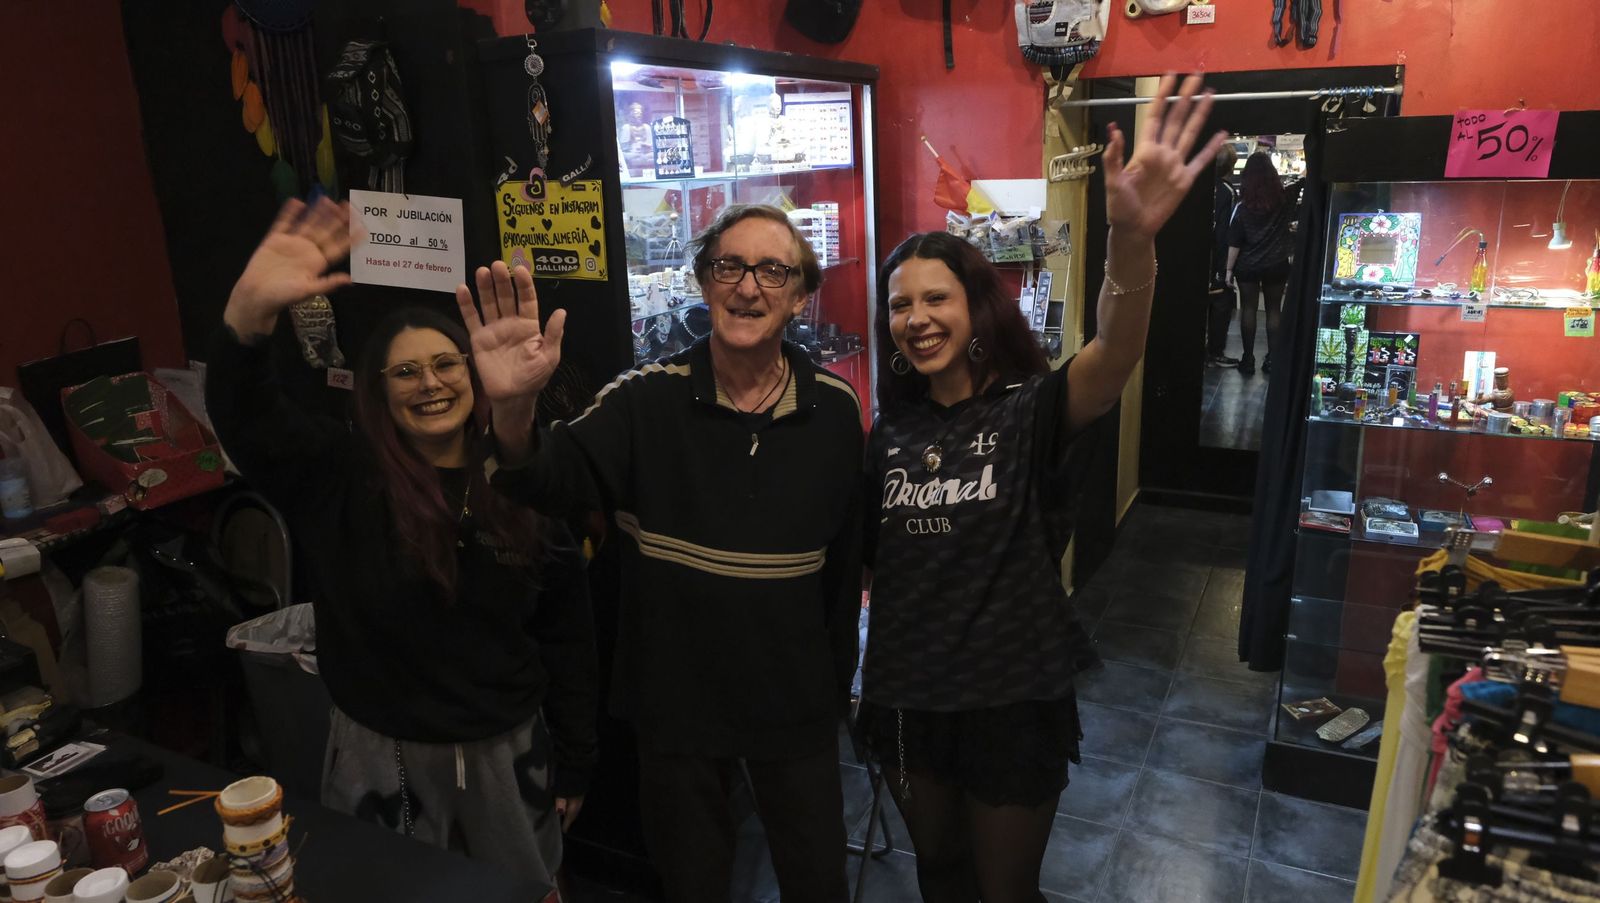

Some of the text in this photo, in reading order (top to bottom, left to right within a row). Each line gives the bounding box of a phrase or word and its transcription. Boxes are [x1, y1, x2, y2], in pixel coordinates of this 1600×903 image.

[1457, 113, 1487, 128] TODO
[1457, 120, 1544, 162] AL 50%
[364, 206, 452, 223] POR JUBILACIÓN
[549, 203, 560, 215] EN
[370, 232, 402, 244] TODO
[409, 237, 418, 246] al
[366, 257, 452, 273] Hasta el 27 de febrero
[536, 255, 578, 264] 400
[906, 517, 952, 535] CLUB
